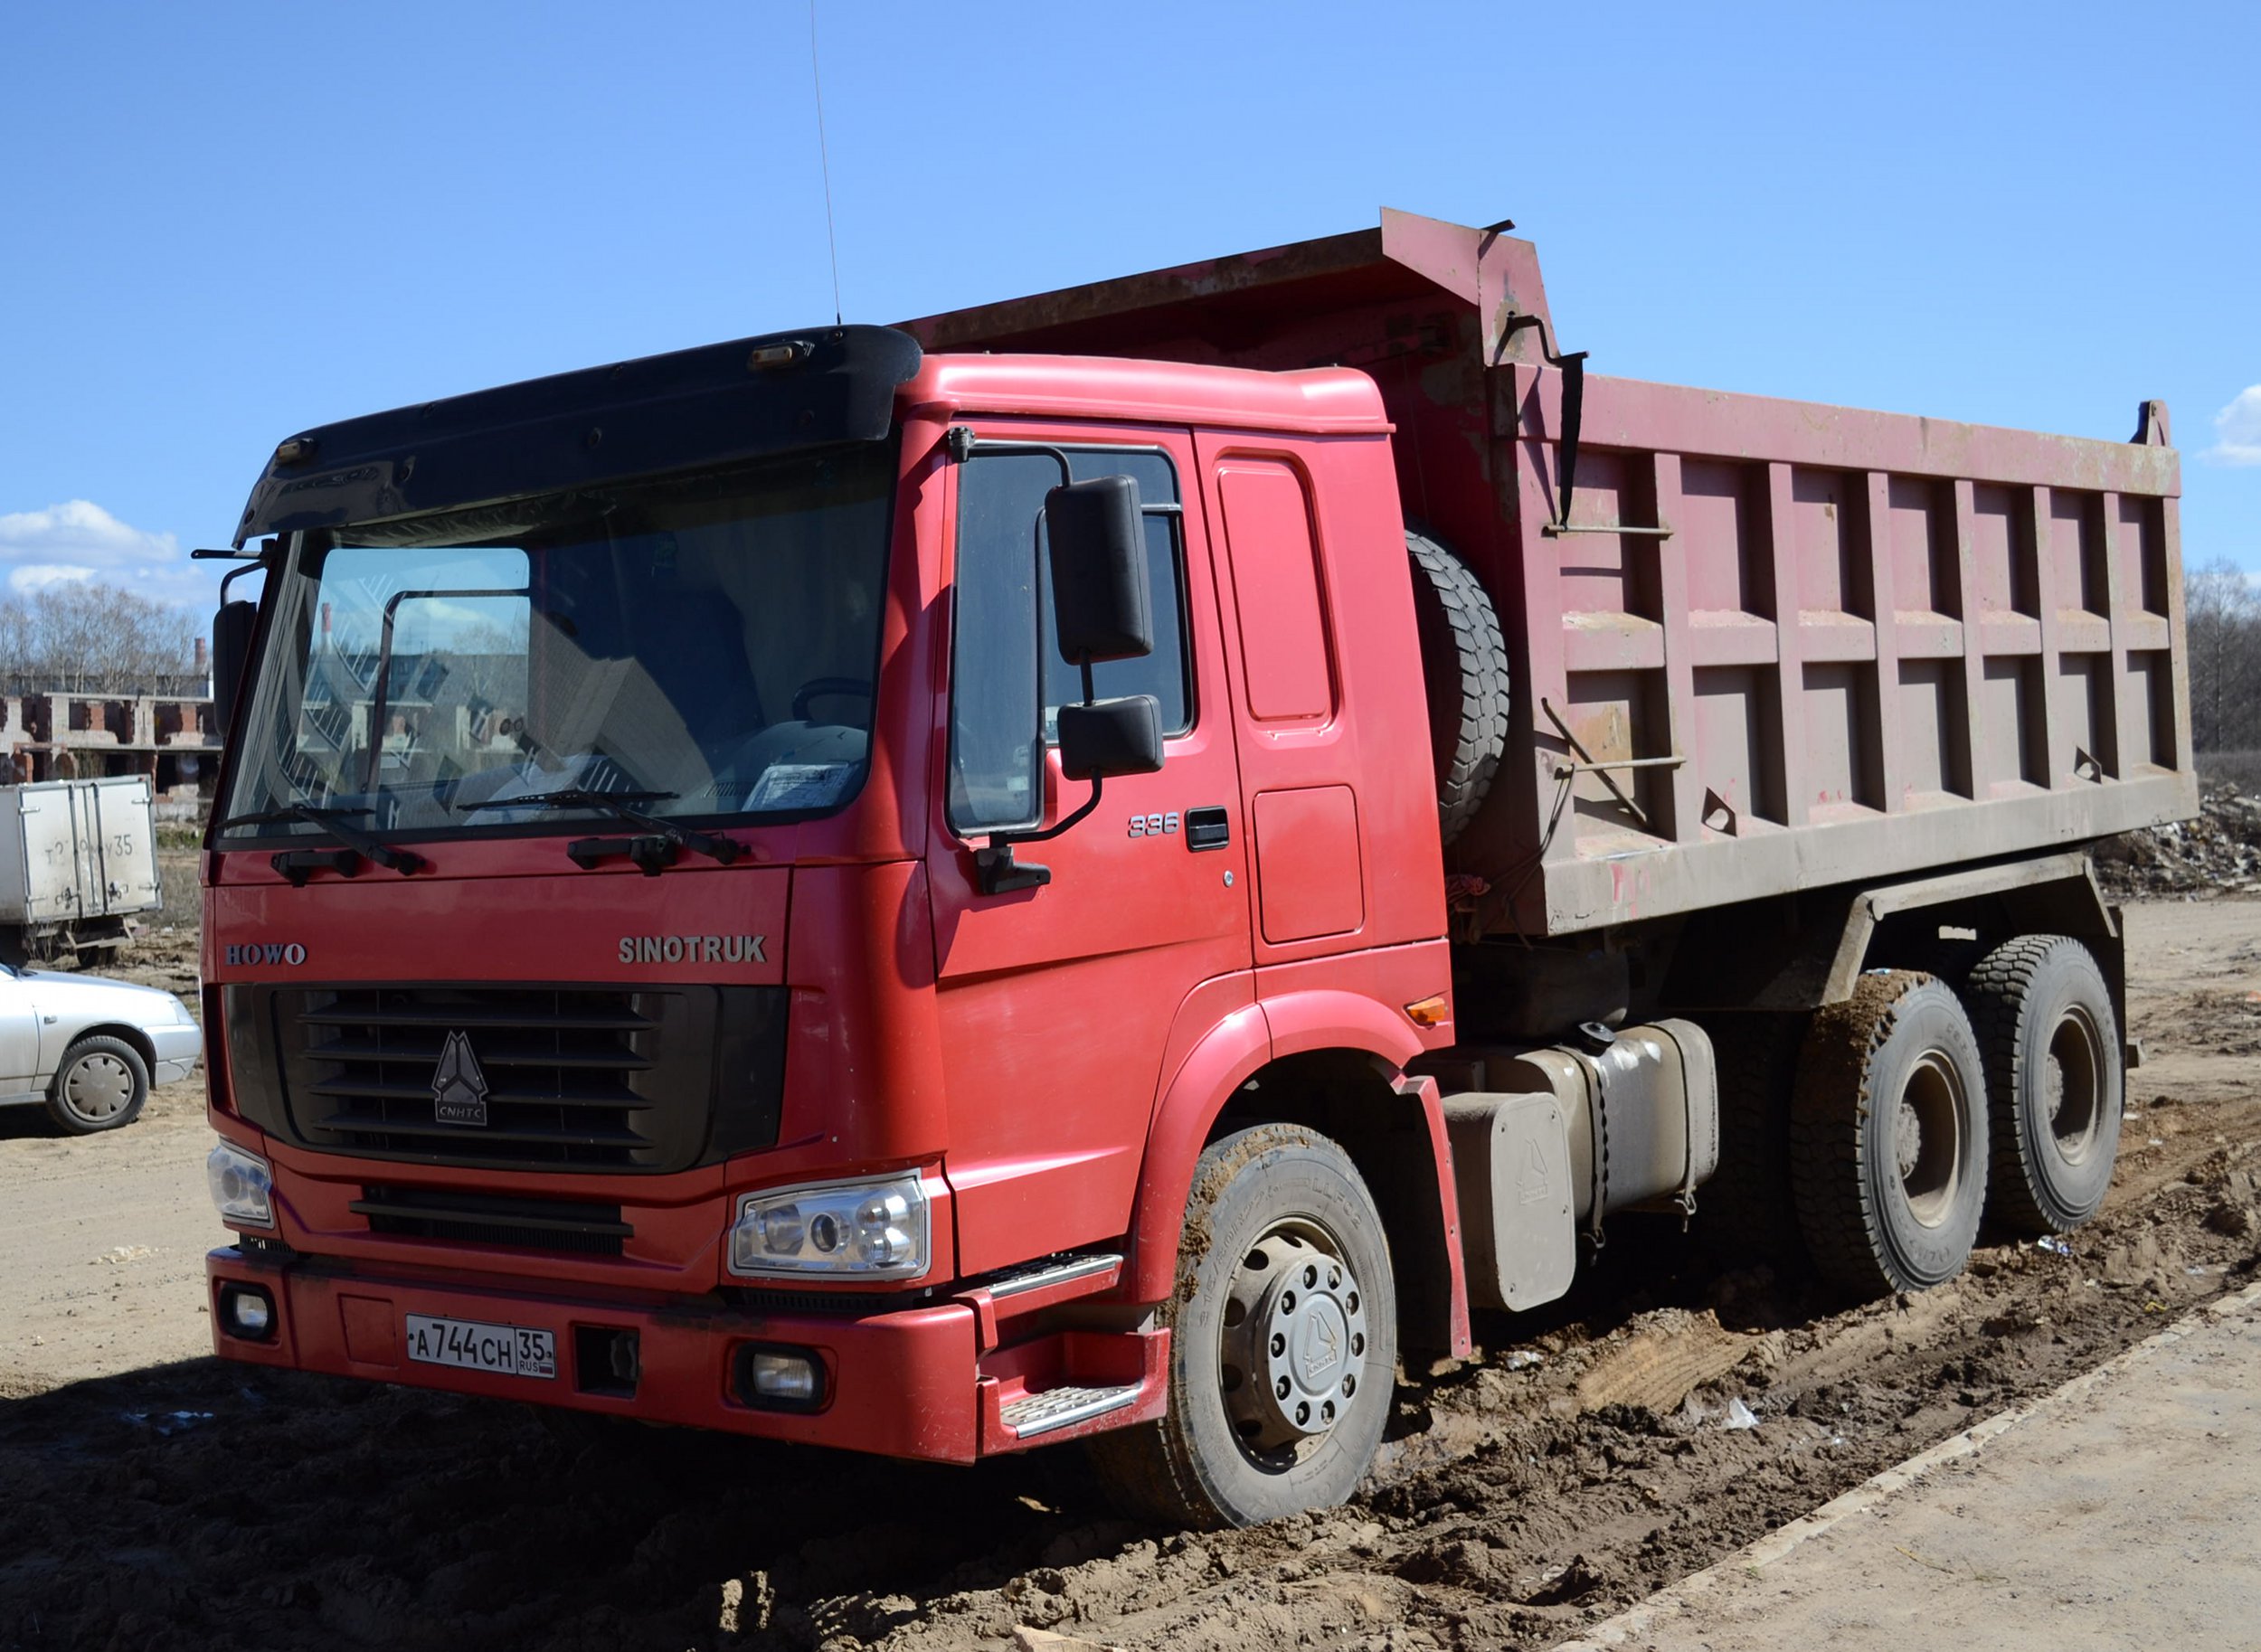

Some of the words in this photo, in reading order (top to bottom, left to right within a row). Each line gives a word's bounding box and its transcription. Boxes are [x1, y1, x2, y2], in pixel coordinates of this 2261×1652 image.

[1128, 812, 1179, 838] 336
[224, 942, 307, 966] HOWO
[618, 935, 768, 963] SINOTRUK
[439, 1105, 482, 1119] CNHTC
[518, 1331, 544, 1361] 35
[519, 1360, 538, 1373] RUS
